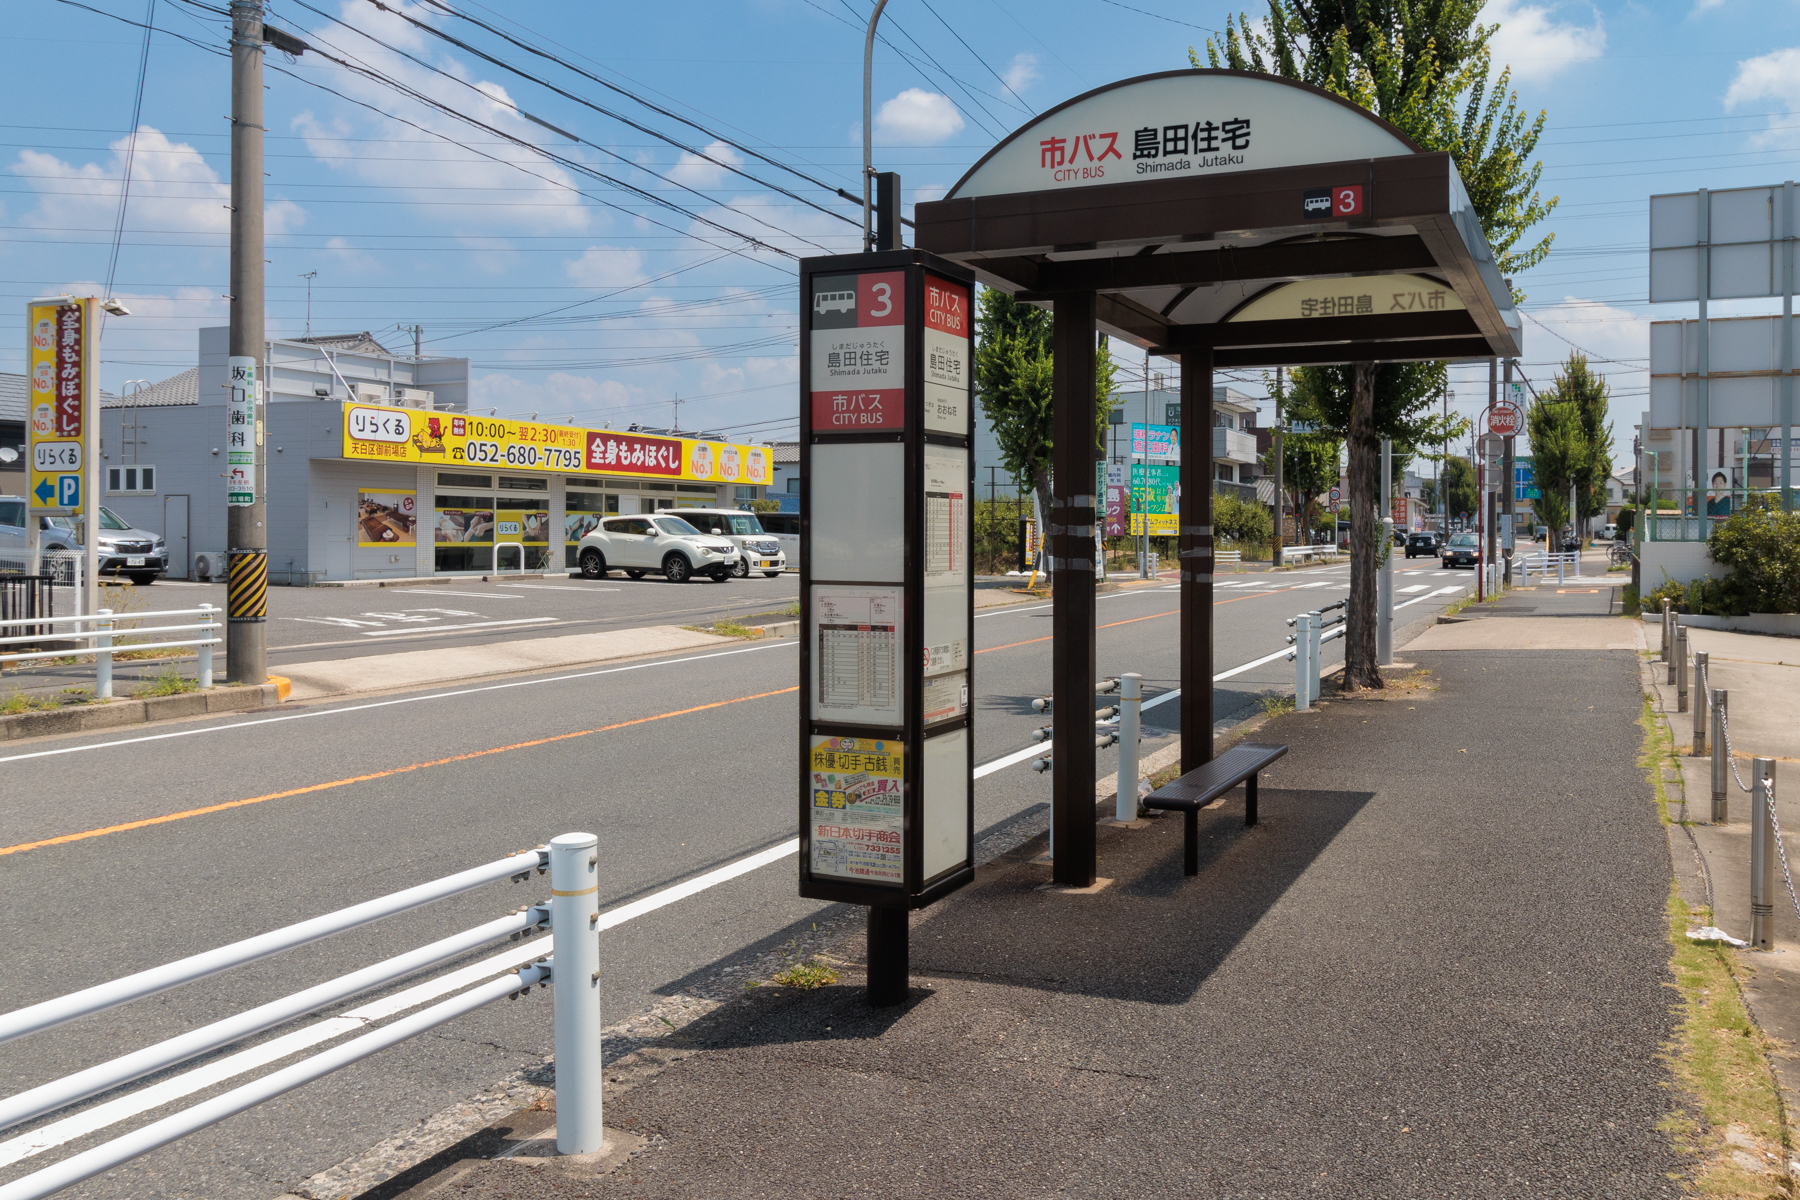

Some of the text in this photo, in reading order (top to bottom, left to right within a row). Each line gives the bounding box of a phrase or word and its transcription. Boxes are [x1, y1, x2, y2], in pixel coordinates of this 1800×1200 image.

[1132, 118, 1251, 161] 島田住宅
[1039, 131, 1123, 170] 市バス
[1136, 152, 1244, 175] Shimada Jutaku
[1054, 165, 1105, 182] CITY BUS
[1339, 190, 1355, 213] 3
[870, 282, 893, 318] 3
[929, 286, 961, 313] 市バス
[929, 309, 961, 330] CITY BUS
[832, 341, 885, 350] しまだじゅうたく
[827, 350, 890, 368] 島田住宅
[929, 353, 961, 375] 島田住宅
[62, 311, 79, 431] 全身もみほぐし
[829, 366, 888, 377] Shimada Jutaku
[930, 370, 960, 383] Shimada Jutaku
[33, 377, 55, 389] No.1
[231, 366, 246, 447] 坂口歯科
[832, 394, 883, 412] 市バス
[33, 419, 55, 431] No.1
[355, 414, 405, 436] りらくる
[832, 412, 883, 425] CITY BUS
[1490, 415, 1515, 427] 消火栓
[37, 448, 78, 465] りらくる
[351, 442, 407, 458] 天白区御前場店
[467, 442, 581, 468] 052-680-7795
[590, 437, 679, 469] 全身もみほぐし
[691, 459, 713, 475] No.1
[719, 462, 740, 477] No.1
[746, 465, 766, 479] No.1
[63, 478, 76, 504] P
[499, 524, 518, 532] りらくる
[876, 779, 900, 793] 買入
[815, 790, 846, 809] 金券
[817, 825, 901, 844] 新日本切手商会
